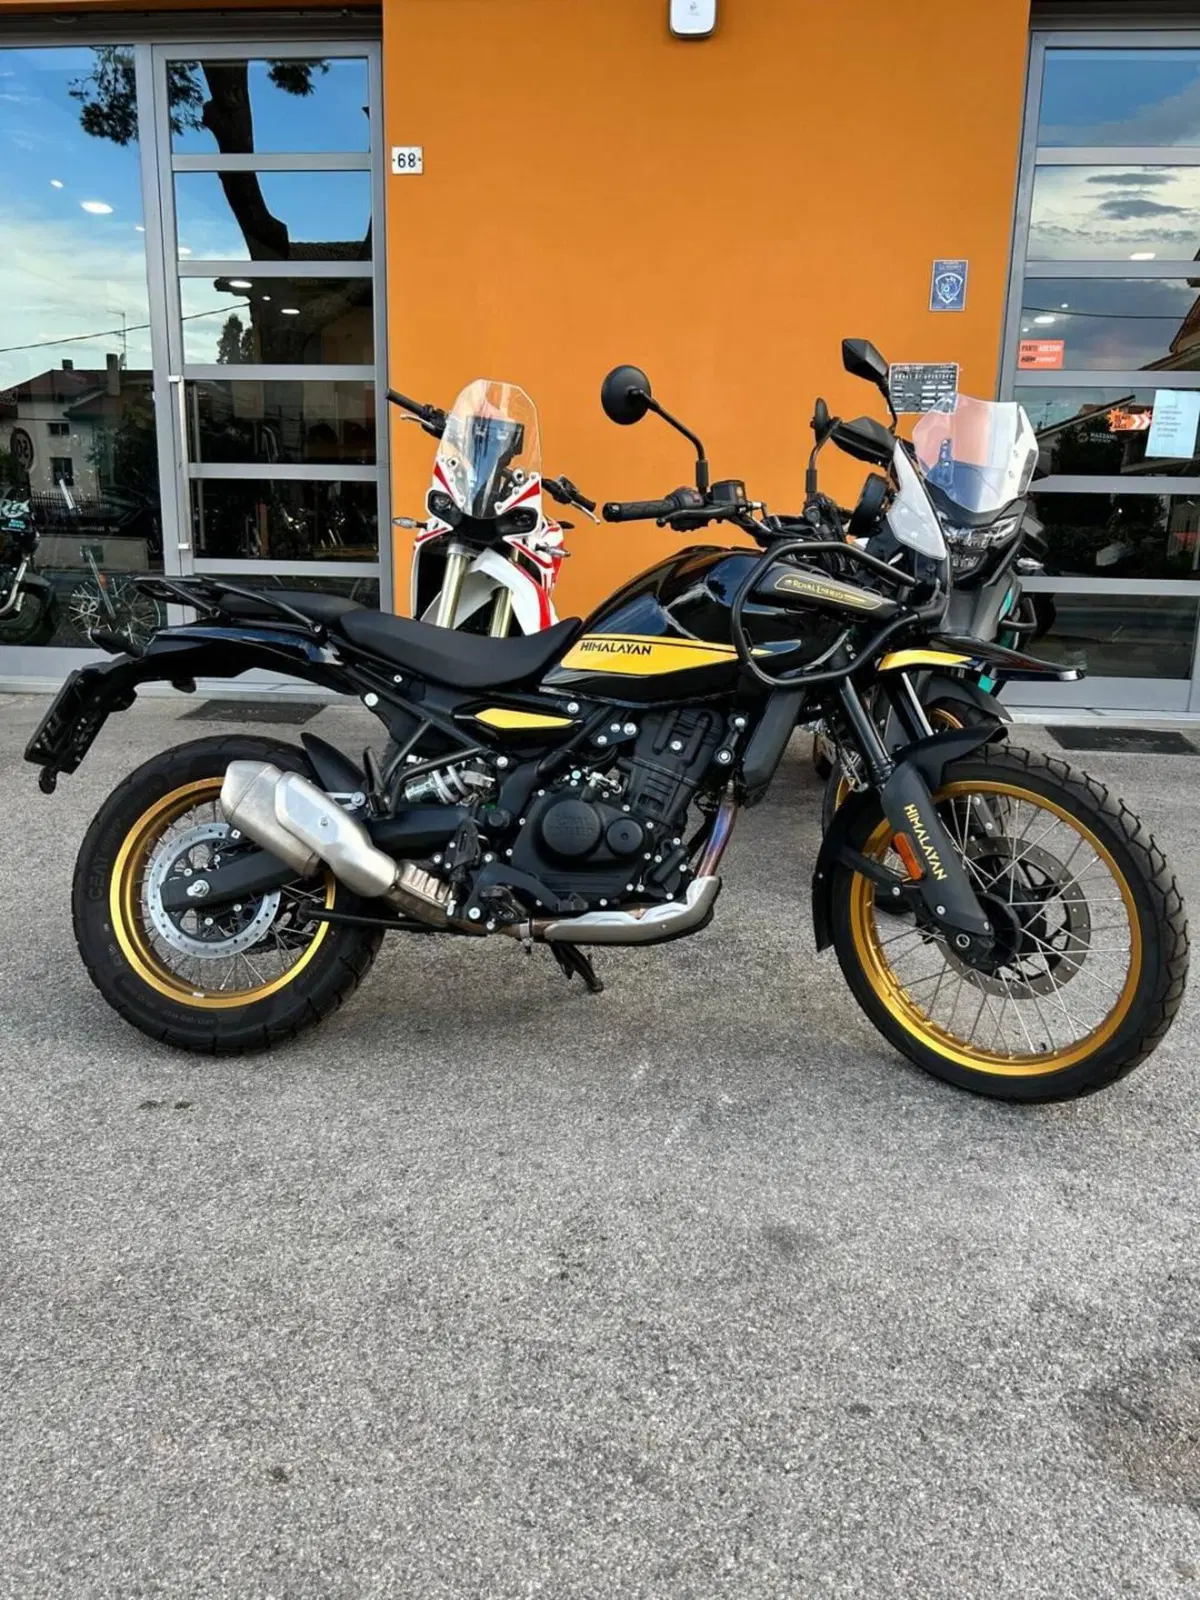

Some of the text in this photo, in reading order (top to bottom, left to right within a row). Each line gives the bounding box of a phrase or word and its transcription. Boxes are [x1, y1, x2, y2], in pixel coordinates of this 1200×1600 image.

[397, 152, 416, 168] 68
[791, 579, 816, 592] ROYAL
[580, 641, 652, 656] HIMALAYAN
[904, 803, 948, 881] HIMALAYAN
